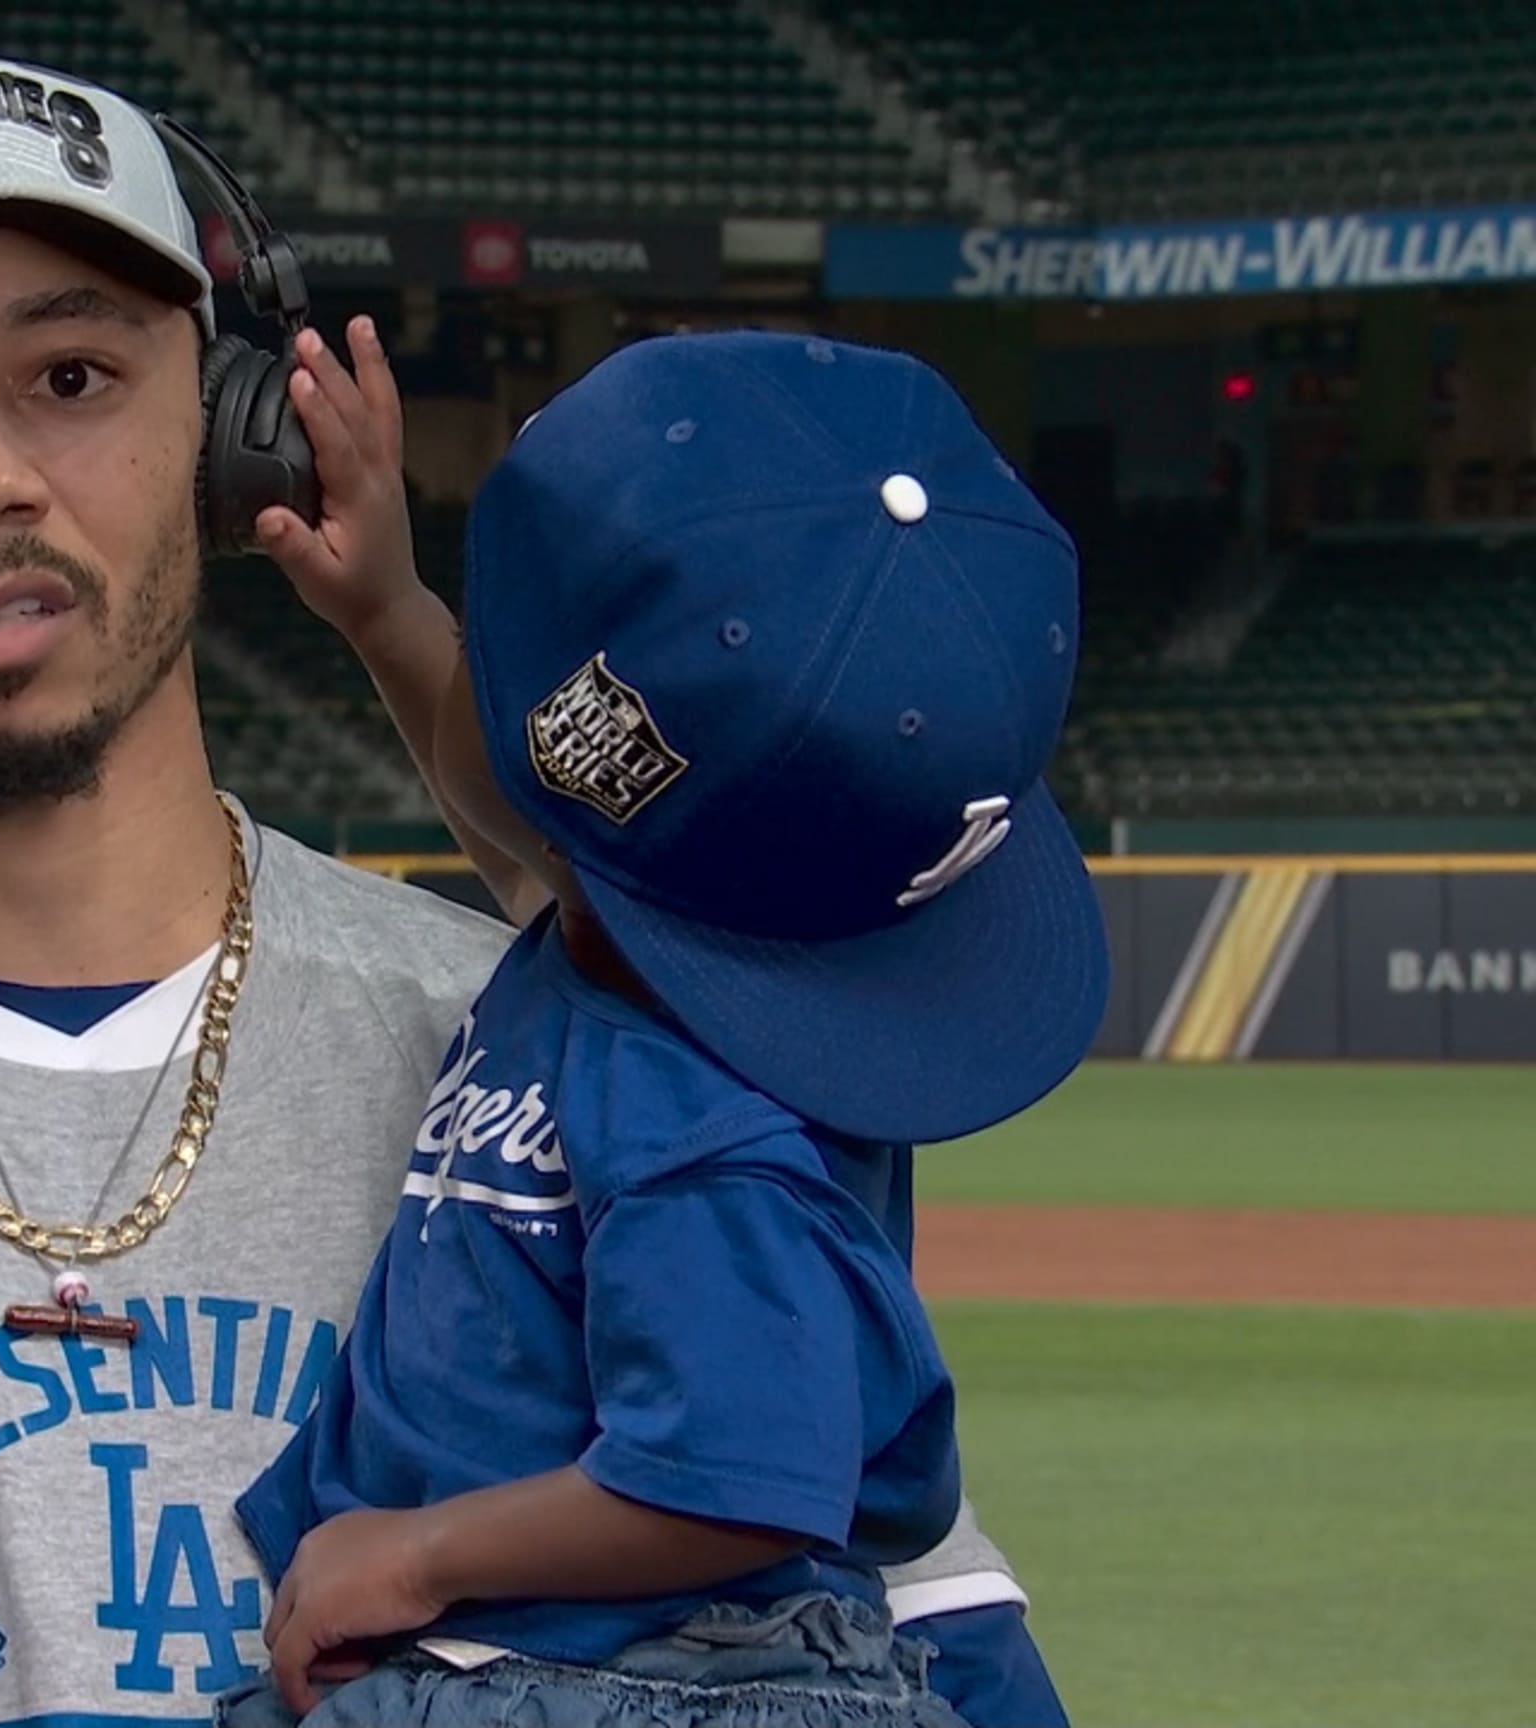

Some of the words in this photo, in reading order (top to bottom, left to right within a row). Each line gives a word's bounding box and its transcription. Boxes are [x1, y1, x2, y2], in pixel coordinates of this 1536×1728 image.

[291, 231, 394, 266] OYOTA
[530, 237, 651, 271] TOYOTA
[539, 692, 632, 803] SERIES
[559, 666, 665, 782] WORLD
[90, 1442, 262, 1693] LA
